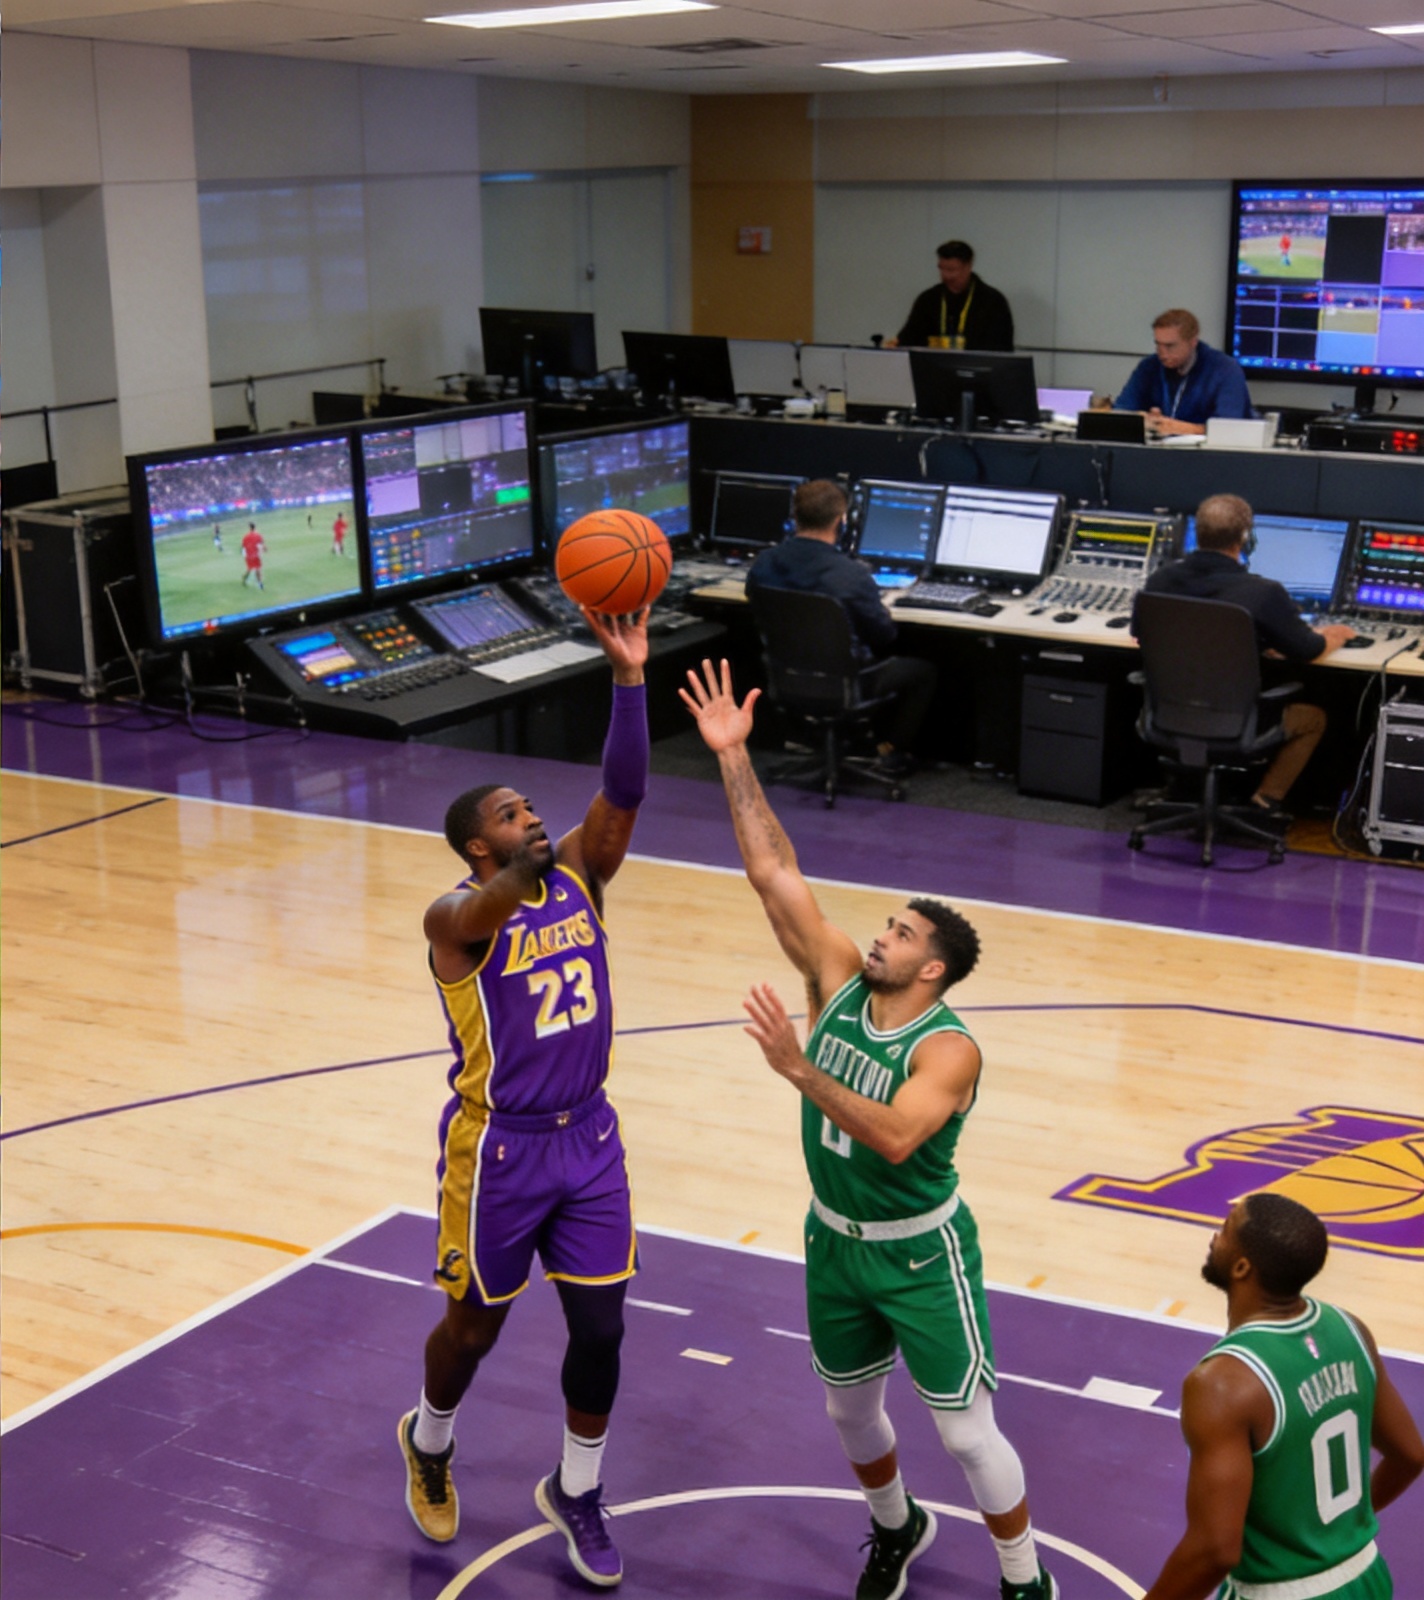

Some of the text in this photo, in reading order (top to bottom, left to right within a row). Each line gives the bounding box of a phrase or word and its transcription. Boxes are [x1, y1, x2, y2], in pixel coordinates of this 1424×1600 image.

[500, 909, 597, 976] LAKERS
[526, 957, 598, 1039] 23
[1311, 1409, 1363, 1525] 0
